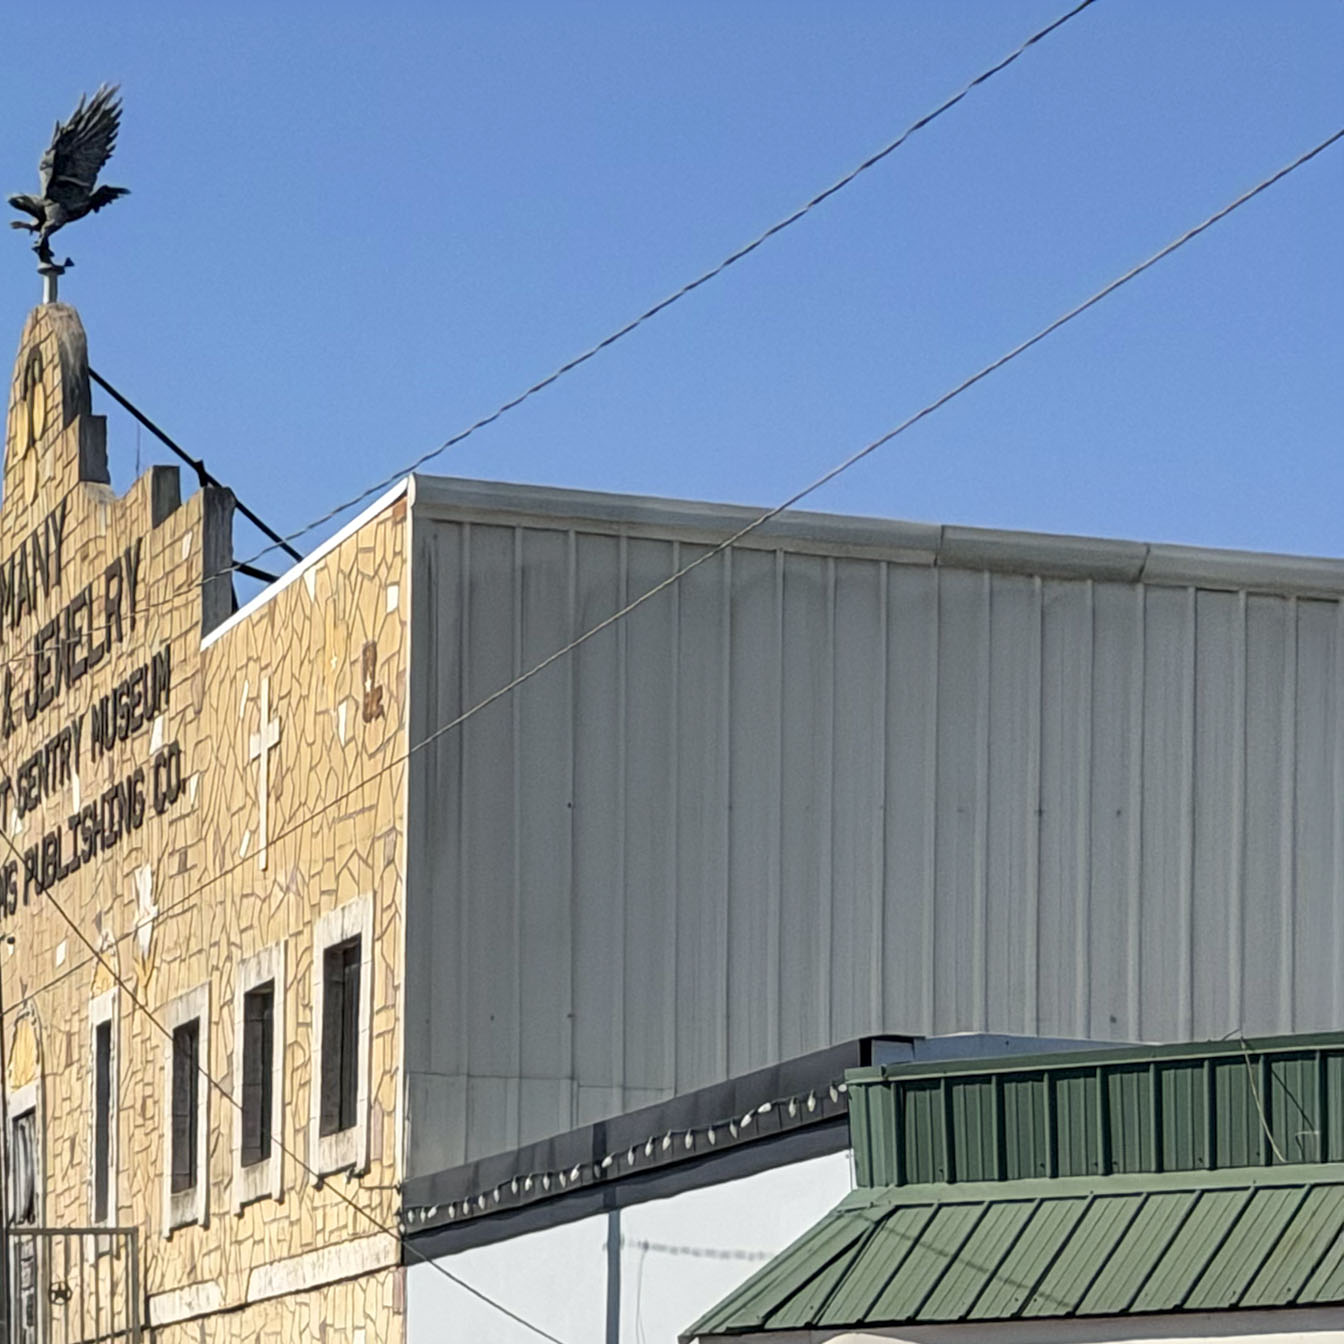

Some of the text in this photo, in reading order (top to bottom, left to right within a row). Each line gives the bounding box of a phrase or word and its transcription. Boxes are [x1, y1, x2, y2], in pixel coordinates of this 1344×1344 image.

[24, 537, 143, 722] JEWELRY
[17, 711, 85, 819] GENTRY
[91, 645, 171, 764] MUSEUM
[24, 767, 145, 905] PUBLISHING
